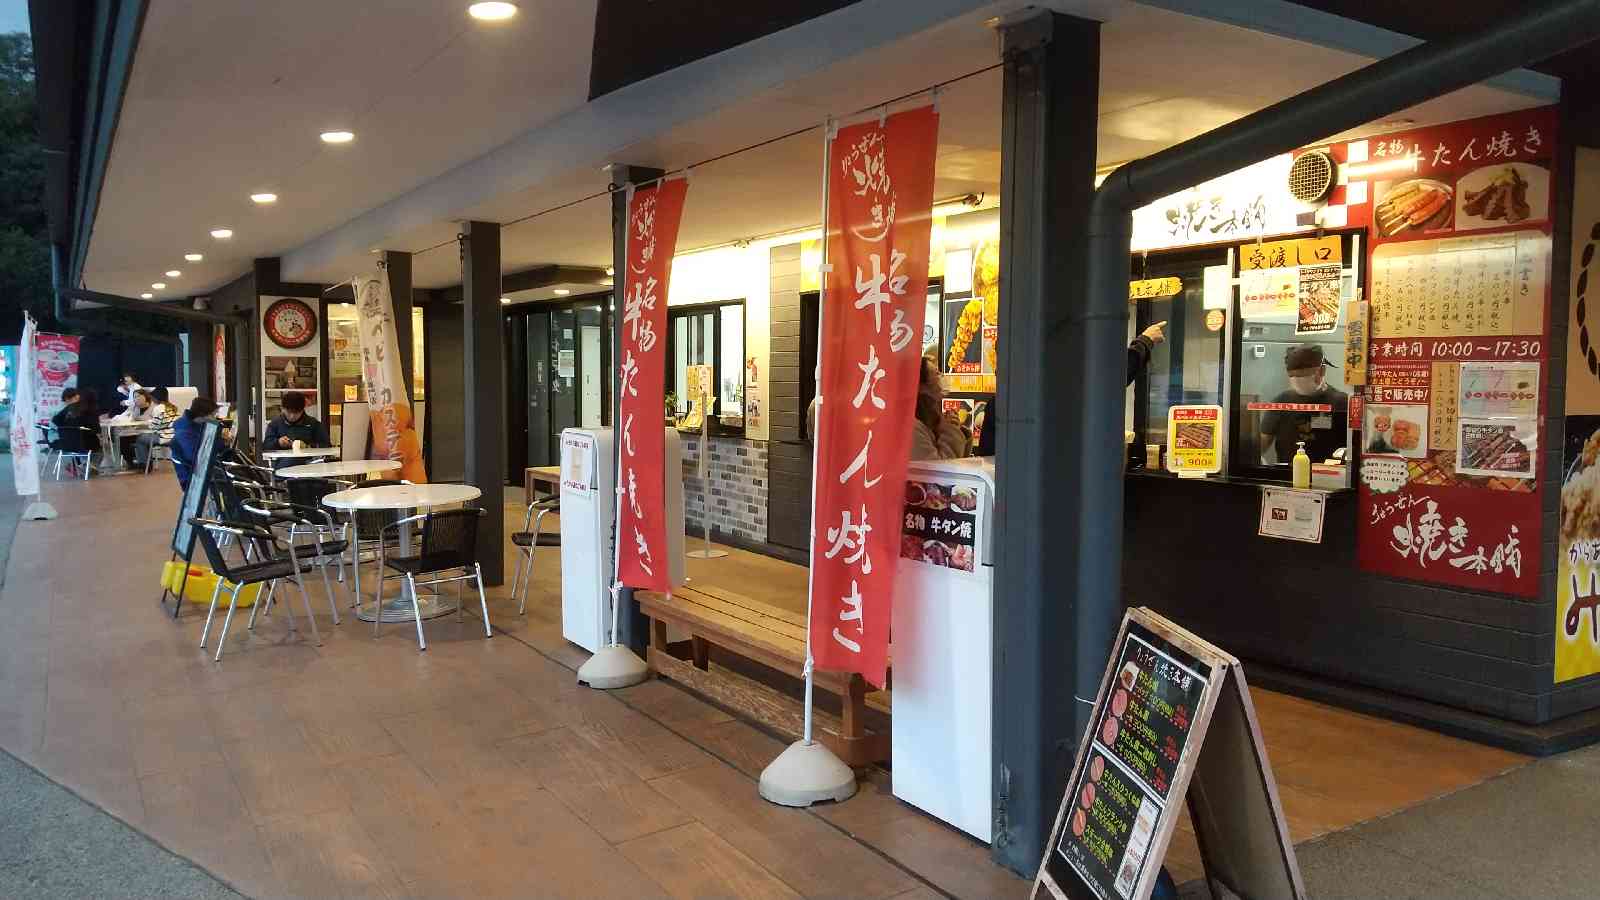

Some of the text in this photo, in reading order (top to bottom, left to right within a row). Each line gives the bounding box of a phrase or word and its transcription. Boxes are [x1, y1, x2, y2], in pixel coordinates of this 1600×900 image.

[1373, 139, 1404, 158] 名物
[1249, 246, 1332, 270] 受渡し口
[824, 253, 892, 653] 牛たん焼き
[905, 512, 973, 539] 名物 牛タン焼
